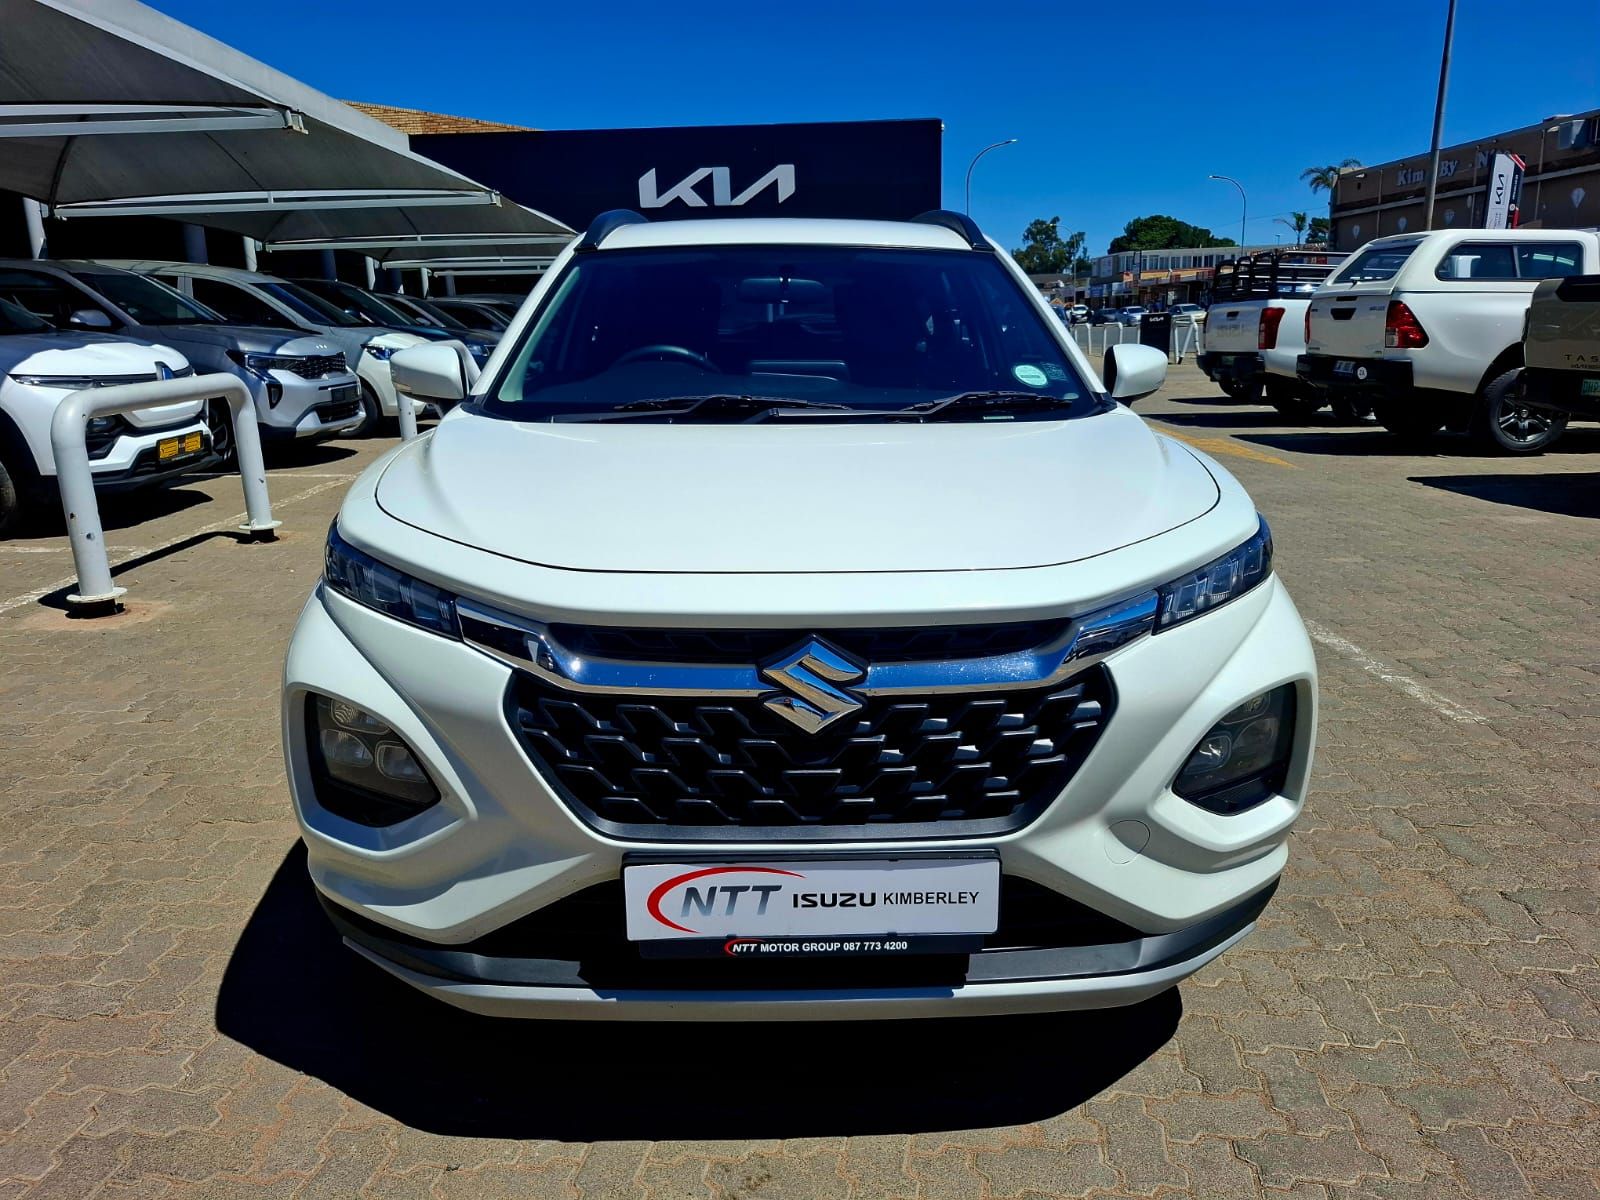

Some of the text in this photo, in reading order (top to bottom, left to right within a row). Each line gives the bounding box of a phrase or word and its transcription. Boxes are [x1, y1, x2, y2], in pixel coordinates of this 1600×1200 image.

[638, 164, 796, 209] KIA
[1495, 174, 1505, 204] KIA
[680, 885, 980, 917] NTT ISUZU KIMBERLEY
[732, 941, 908, 953] NTT MOTOR GROUP 087 773 4200
